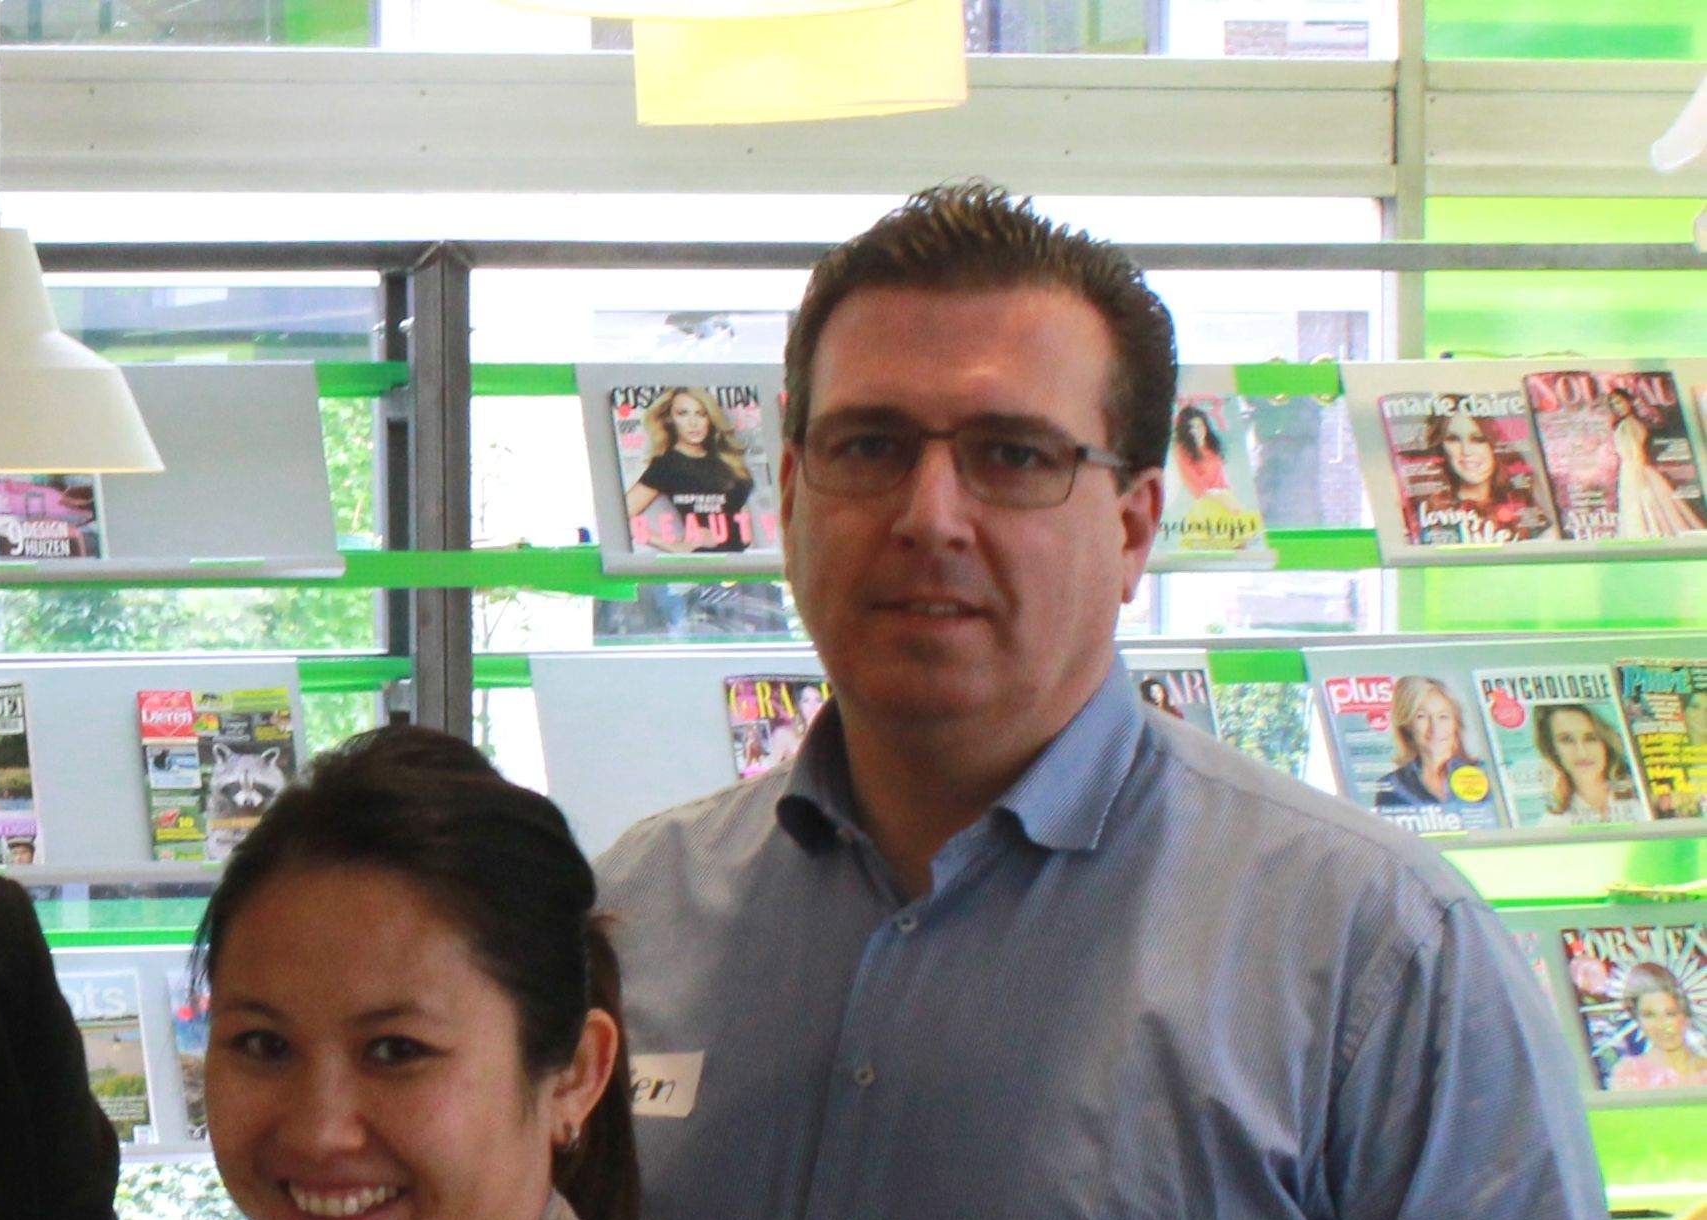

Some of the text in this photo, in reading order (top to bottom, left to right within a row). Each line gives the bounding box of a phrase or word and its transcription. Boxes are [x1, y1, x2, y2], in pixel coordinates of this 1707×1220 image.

[1382, 391, 1525, 418] marie claire
[630, 511, 779, 544] BEAUTY
[1329, 677, 1392, 713] plus
